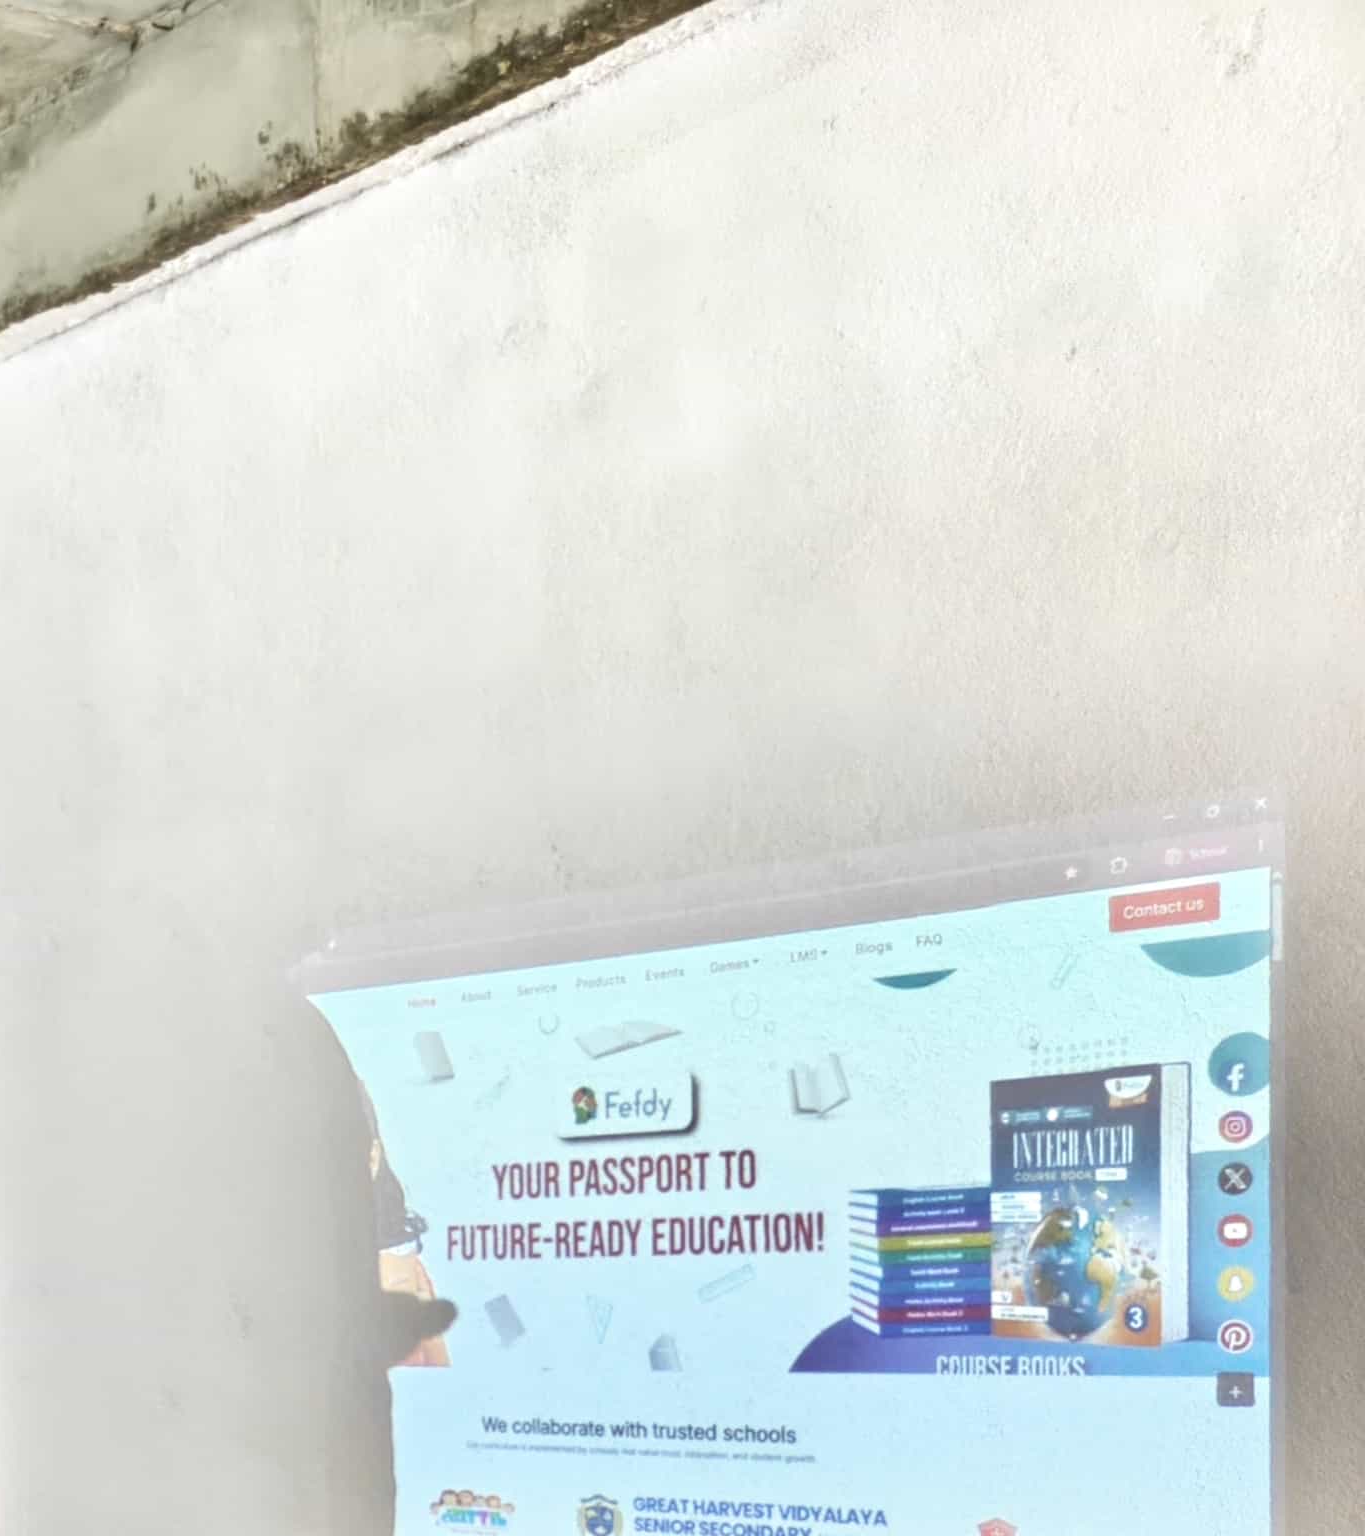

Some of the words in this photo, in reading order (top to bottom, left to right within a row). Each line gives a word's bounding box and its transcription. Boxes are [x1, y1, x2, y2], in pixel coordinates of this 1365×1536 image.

[1123, 900, 1182, 920] Contact
[1185, 898, 1204, 912] us
[461, 989, 493, 1003] About
[516, 982, 558, 997] Service
[575, 973, 628, 990] Products
[644, 967, 685, 982] Events
[710, 957, 750, 974] Games
[855, 941, 893, 956] Blogs
[916, 933, 944, 948] FAQ
[604, 1087, 672, 1121] Fefdy
[492, 1161, 560, 1200] YOUR
[569, 1151, 711, 1197] PASSPORT
[719, 1149, 757, 1189] TO
[446, 1219, 642, 1260] FUTURE-READY
[651, 1211, 825, 1256] EDUCATION!
[1128, 1307, 1144, 1329] 3
[936, 1355, 1013, 1376] COURSE
[1018, 1356, 1086, 1377] BOOKS
[482, 1416, 507, 1433] We
[512, 1418, 605, 1438] collaborate
[610, 1420, 647, 1439] with
[652, 1422, 717, 1441] trusted
[723, 1424, 797, 1444] schools
[633, 1497, 689, 1513] GREAT
[693, 1500, 774, 1519] HARVEST
[779, 1504, 888, 1527] VIDYALAYA
[634, 1517, 695, 1536] SENIOR
